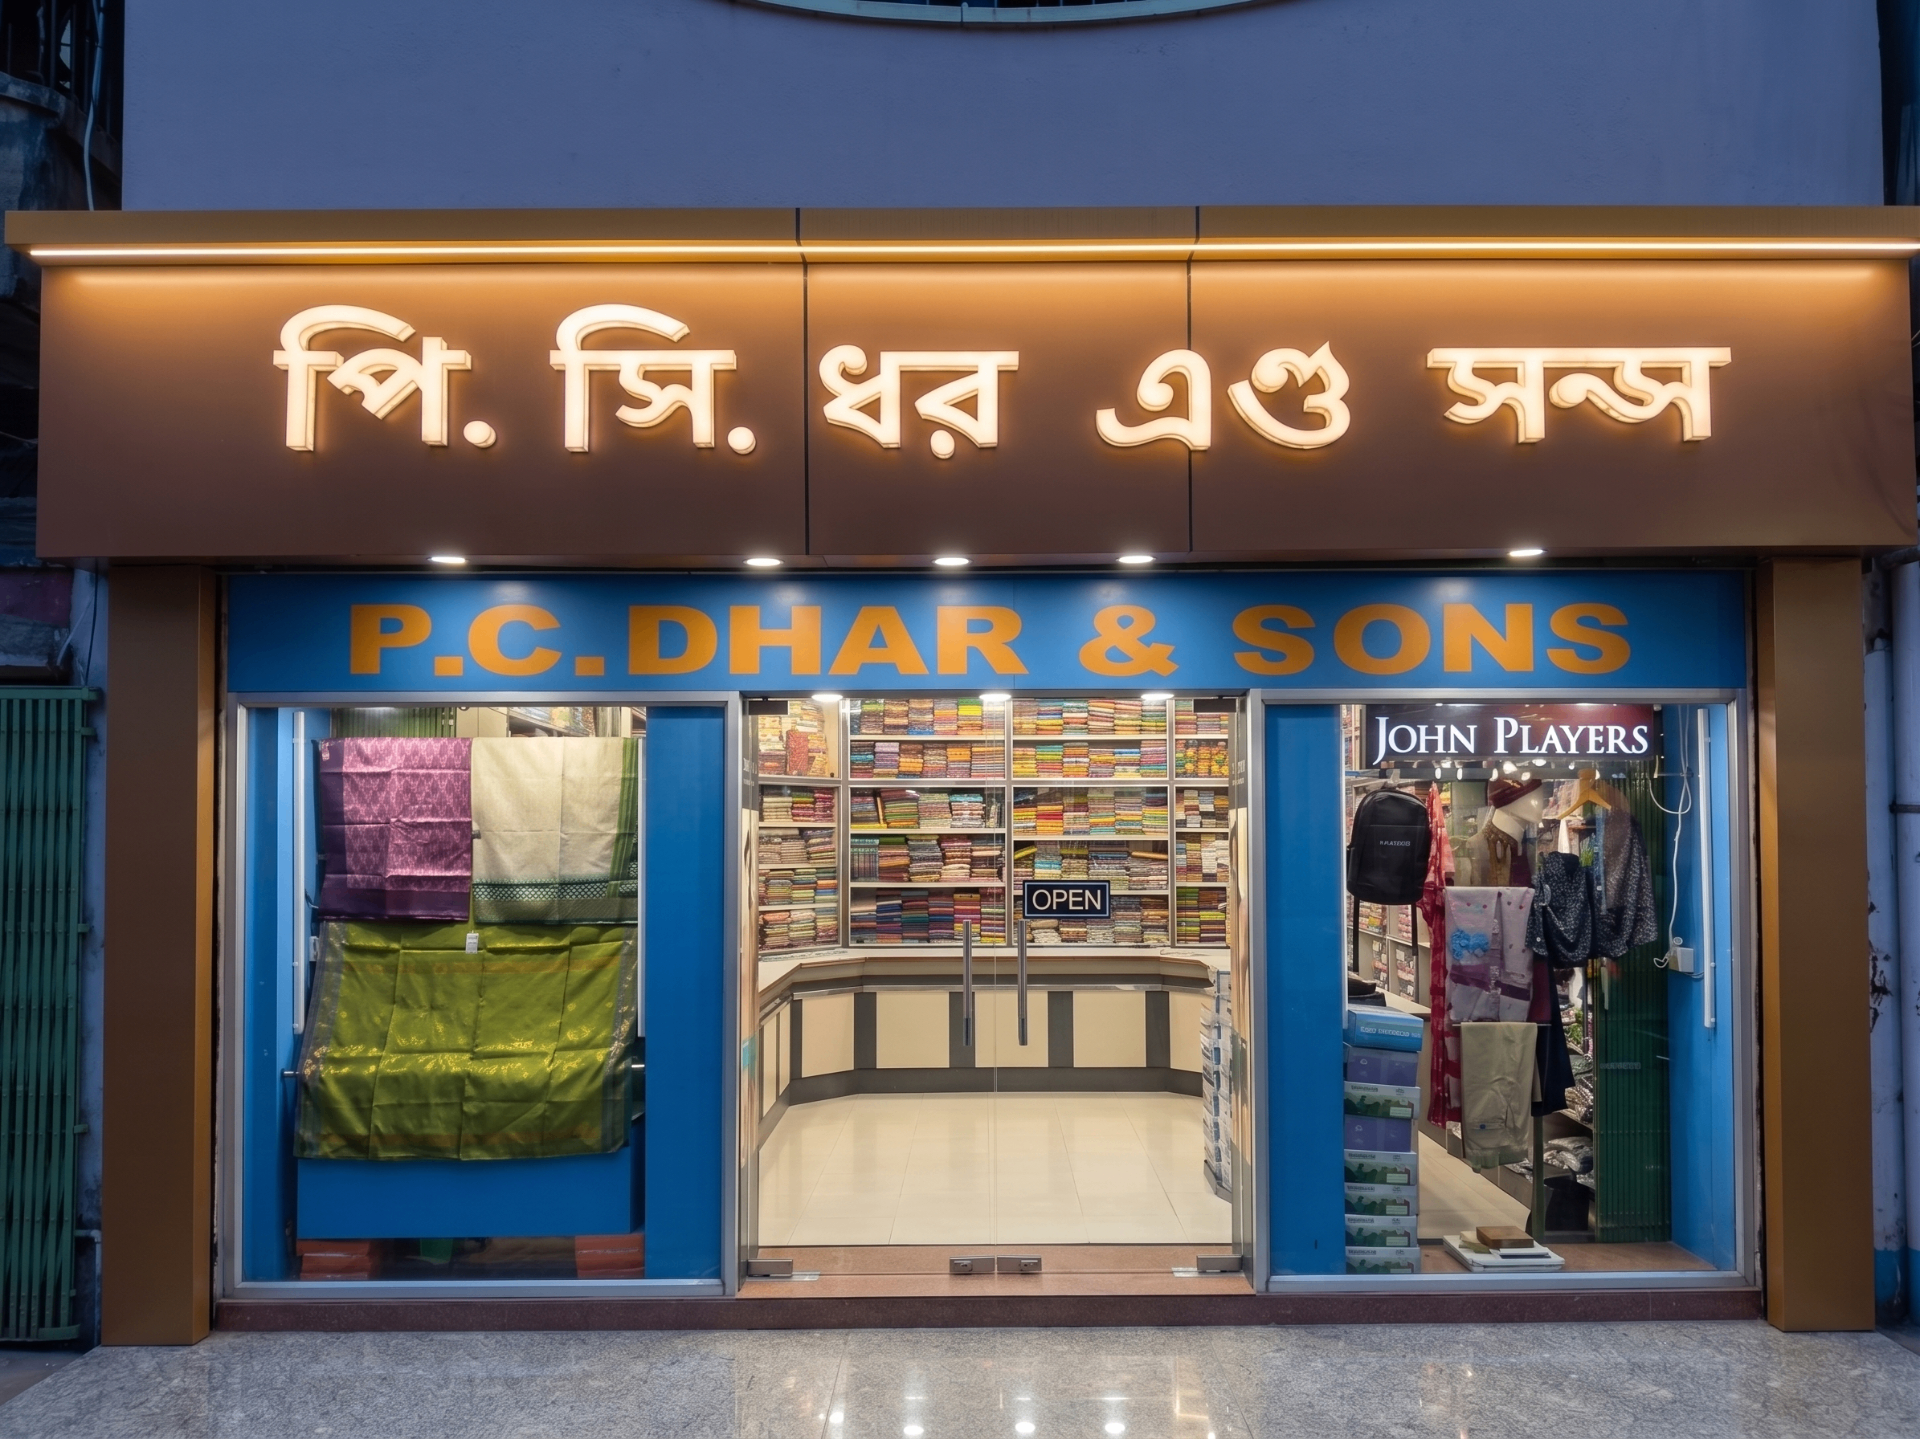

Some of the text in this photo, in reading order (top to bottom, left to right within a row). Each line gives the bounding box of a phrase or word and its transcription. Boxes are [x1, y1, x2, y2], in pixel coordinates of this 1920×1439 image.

[273, 304, 496, 451] পি.
[550, 304, 756, 454] সি.
[819, 344, 1019, 459] ধর
[1427, 347, 1732, 444] সন্স
[1079, 604, 1179, 677] &
[1232, 602, 1631, 675] SONS
[1372, 716, 1650, 766] JOHN PLAYERS
[1032, 889, 1101, 910] OPEN
